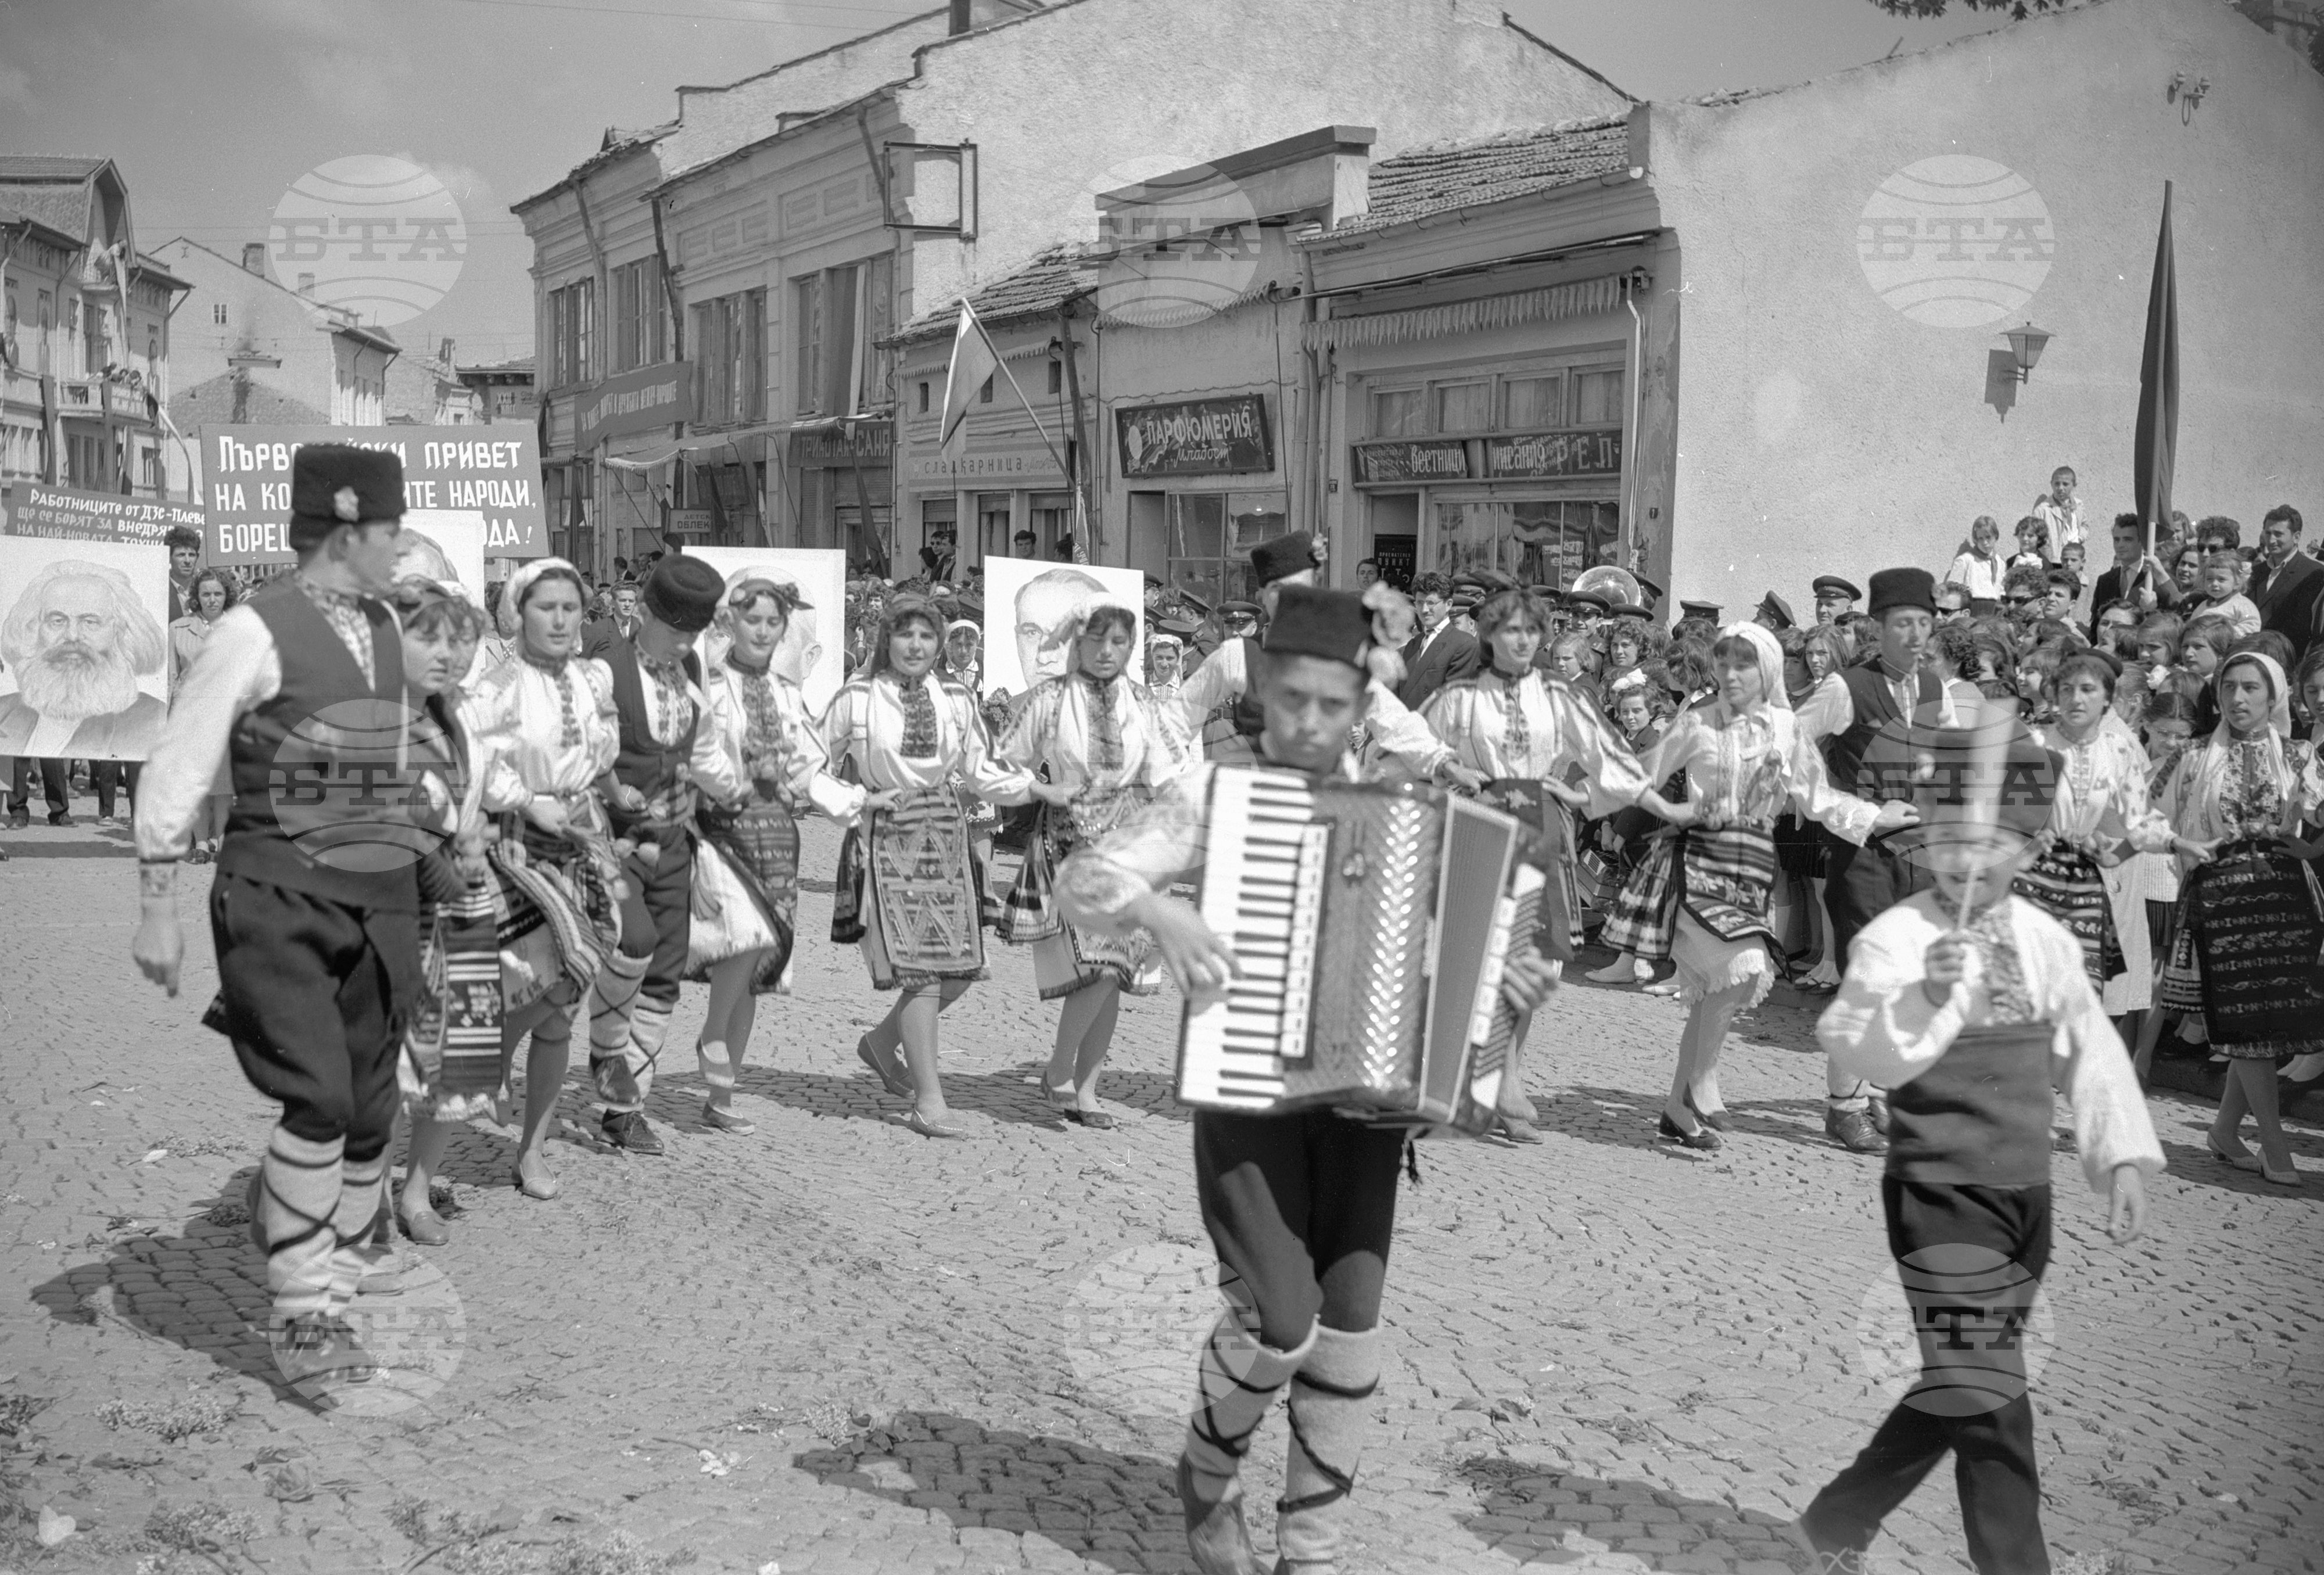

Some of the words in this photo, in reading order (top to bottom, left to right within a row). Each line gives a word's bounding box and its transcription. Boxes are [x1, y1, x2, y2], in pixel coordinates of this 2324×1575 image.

[1146, 410, 1253, 446] ПАРФЮМЕРИЯ
[424, 440, 522, 469] ПРИВЕТ
[215, 483, 246, 511] НА
[449, 479, 536, 509] НАРОДИ,
[17, 523, 34, 536] НА
[39, 510, 53, 522] СЕ
[55, 512, 94, 528] БОРЯТ
[96, 517, 113, 530] ЗА
[677, 521, 710, 529] ОБЛЕК
